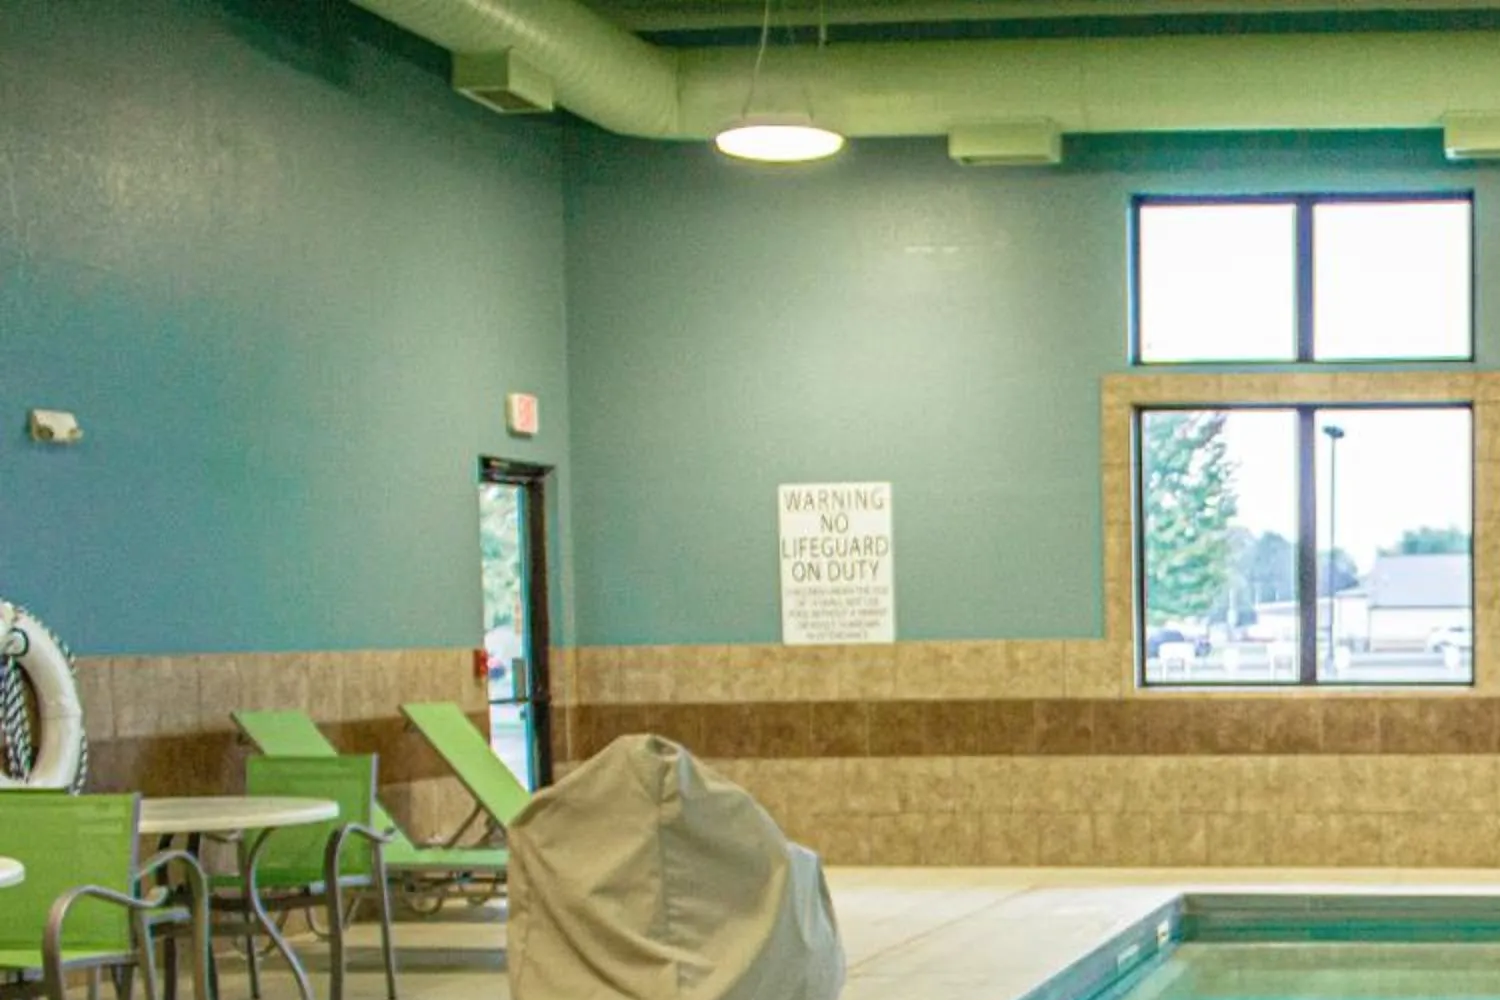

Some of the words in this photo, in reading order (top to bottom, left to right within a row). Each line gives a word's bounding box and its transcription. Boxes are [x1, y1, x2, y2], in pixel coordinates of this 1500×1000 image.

[783, 488, 884, 512] WARNING
[820, 512, 849, 534] NO
[781, 535, 889, 559] LIFEGUARD
[791, 561, 821, 583] ON
[827, 560, 880, 582] DUTY
